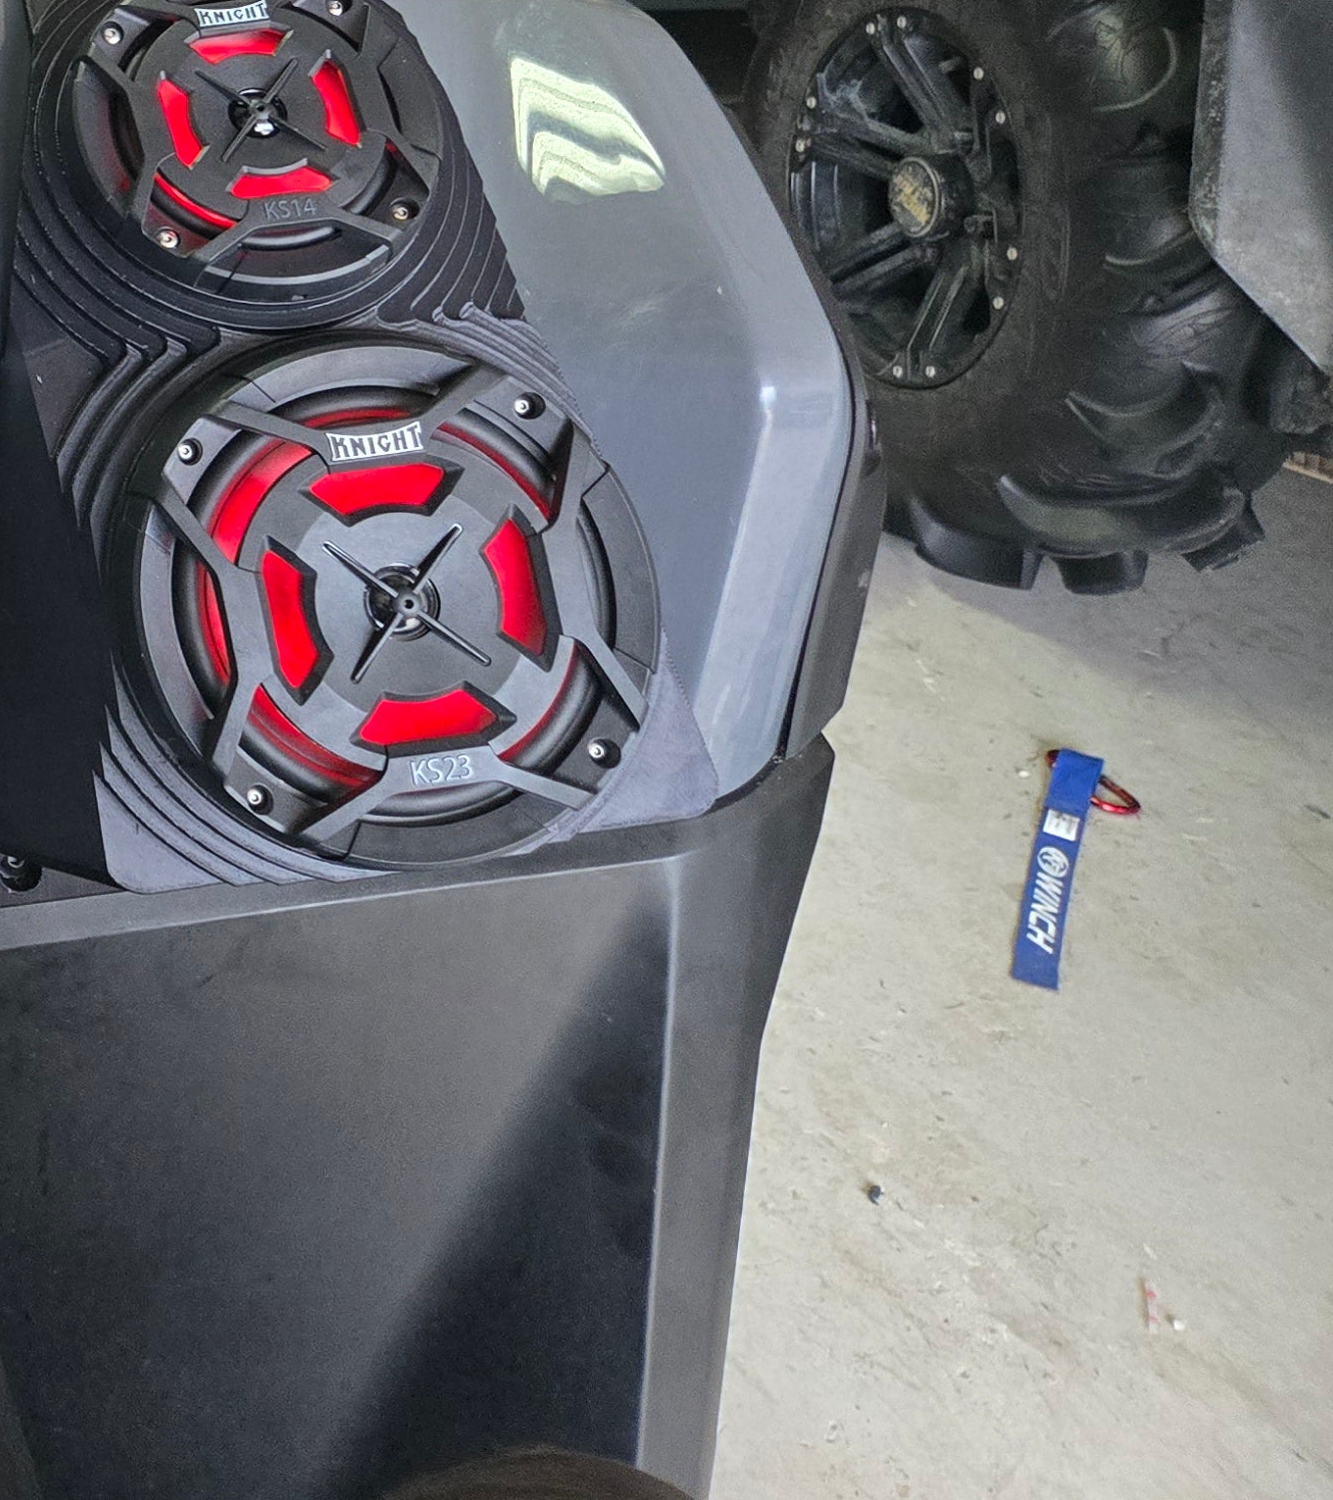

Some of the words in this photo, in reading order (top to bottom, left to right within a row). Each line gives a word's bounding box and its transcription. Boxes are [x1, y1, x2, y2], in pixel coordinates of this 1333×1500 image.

[199, 2, 266, 25] KNIGHT
[264, 198, 318, 220] KS14
[330, 424, 420, 459] KNIGHT
[410, 754, 473, 786] KS23
[1026, 871, 1065, 955] WINCH
